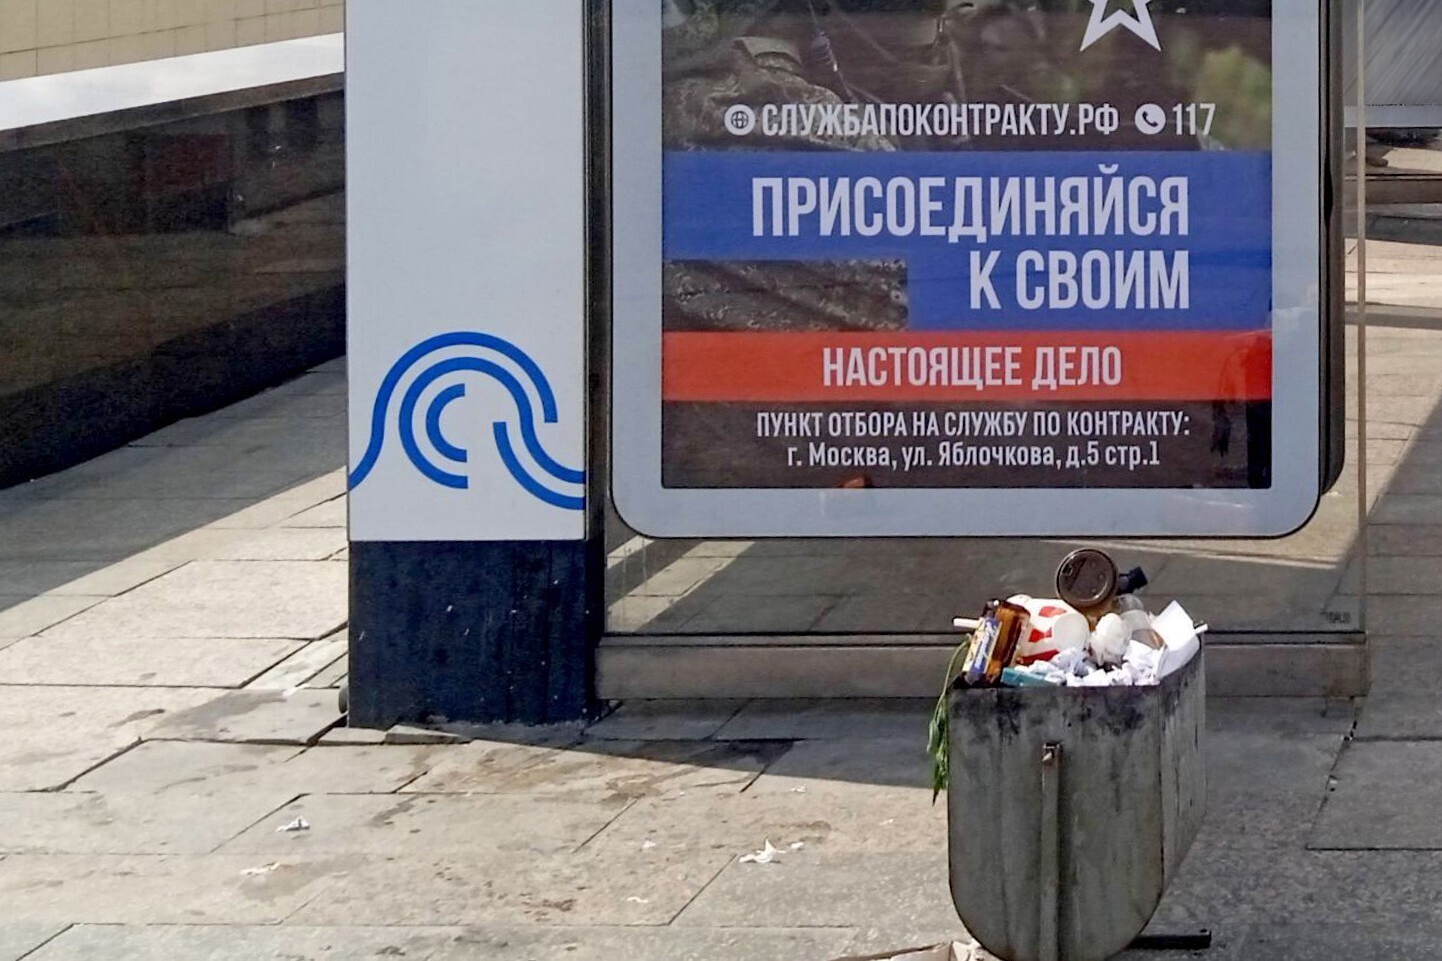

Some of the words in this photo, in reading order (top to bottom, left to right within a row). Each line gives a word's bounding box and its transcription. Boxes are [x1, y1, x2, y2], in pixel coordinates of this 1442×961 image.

[762, 103, 1119, 136] СЛУЖБАПОКОНТРАКТУ.РФ
[1172, 103, 1216, 136] 117
[752, 164, 1189, 243] ПРИСОЕДИНЯЙСЯ
[970, 250, 1001, 310] К
[1016, 249, 1190, 310] СВОИМ
[823, 346, 1022, 390] НАСТОЯЩЕЕ
[1032, 346, 1121, 390] ДЕЛО
[757, 412, 823, 437] ПУНКТ
[828, 411, 908, 437] ОТБОРА
[913, 411, 940, 436] НА
[945, 411, 1028, 436] СЛУЖБУ
[1033, 411, 1060, 436] ПО
[1067, 411, 1190, 436] КОНТРАКТУ:
[787, 446, 803, 467] г.
[808, 442, 898, 471] Москва,
[902, 446, 933, 472] ул.
[938, 441, 1062, 470] Яблочкова,
[1066, 441, 1099, 468] д.5
[1105, 440, 1160, 470] стр.1
